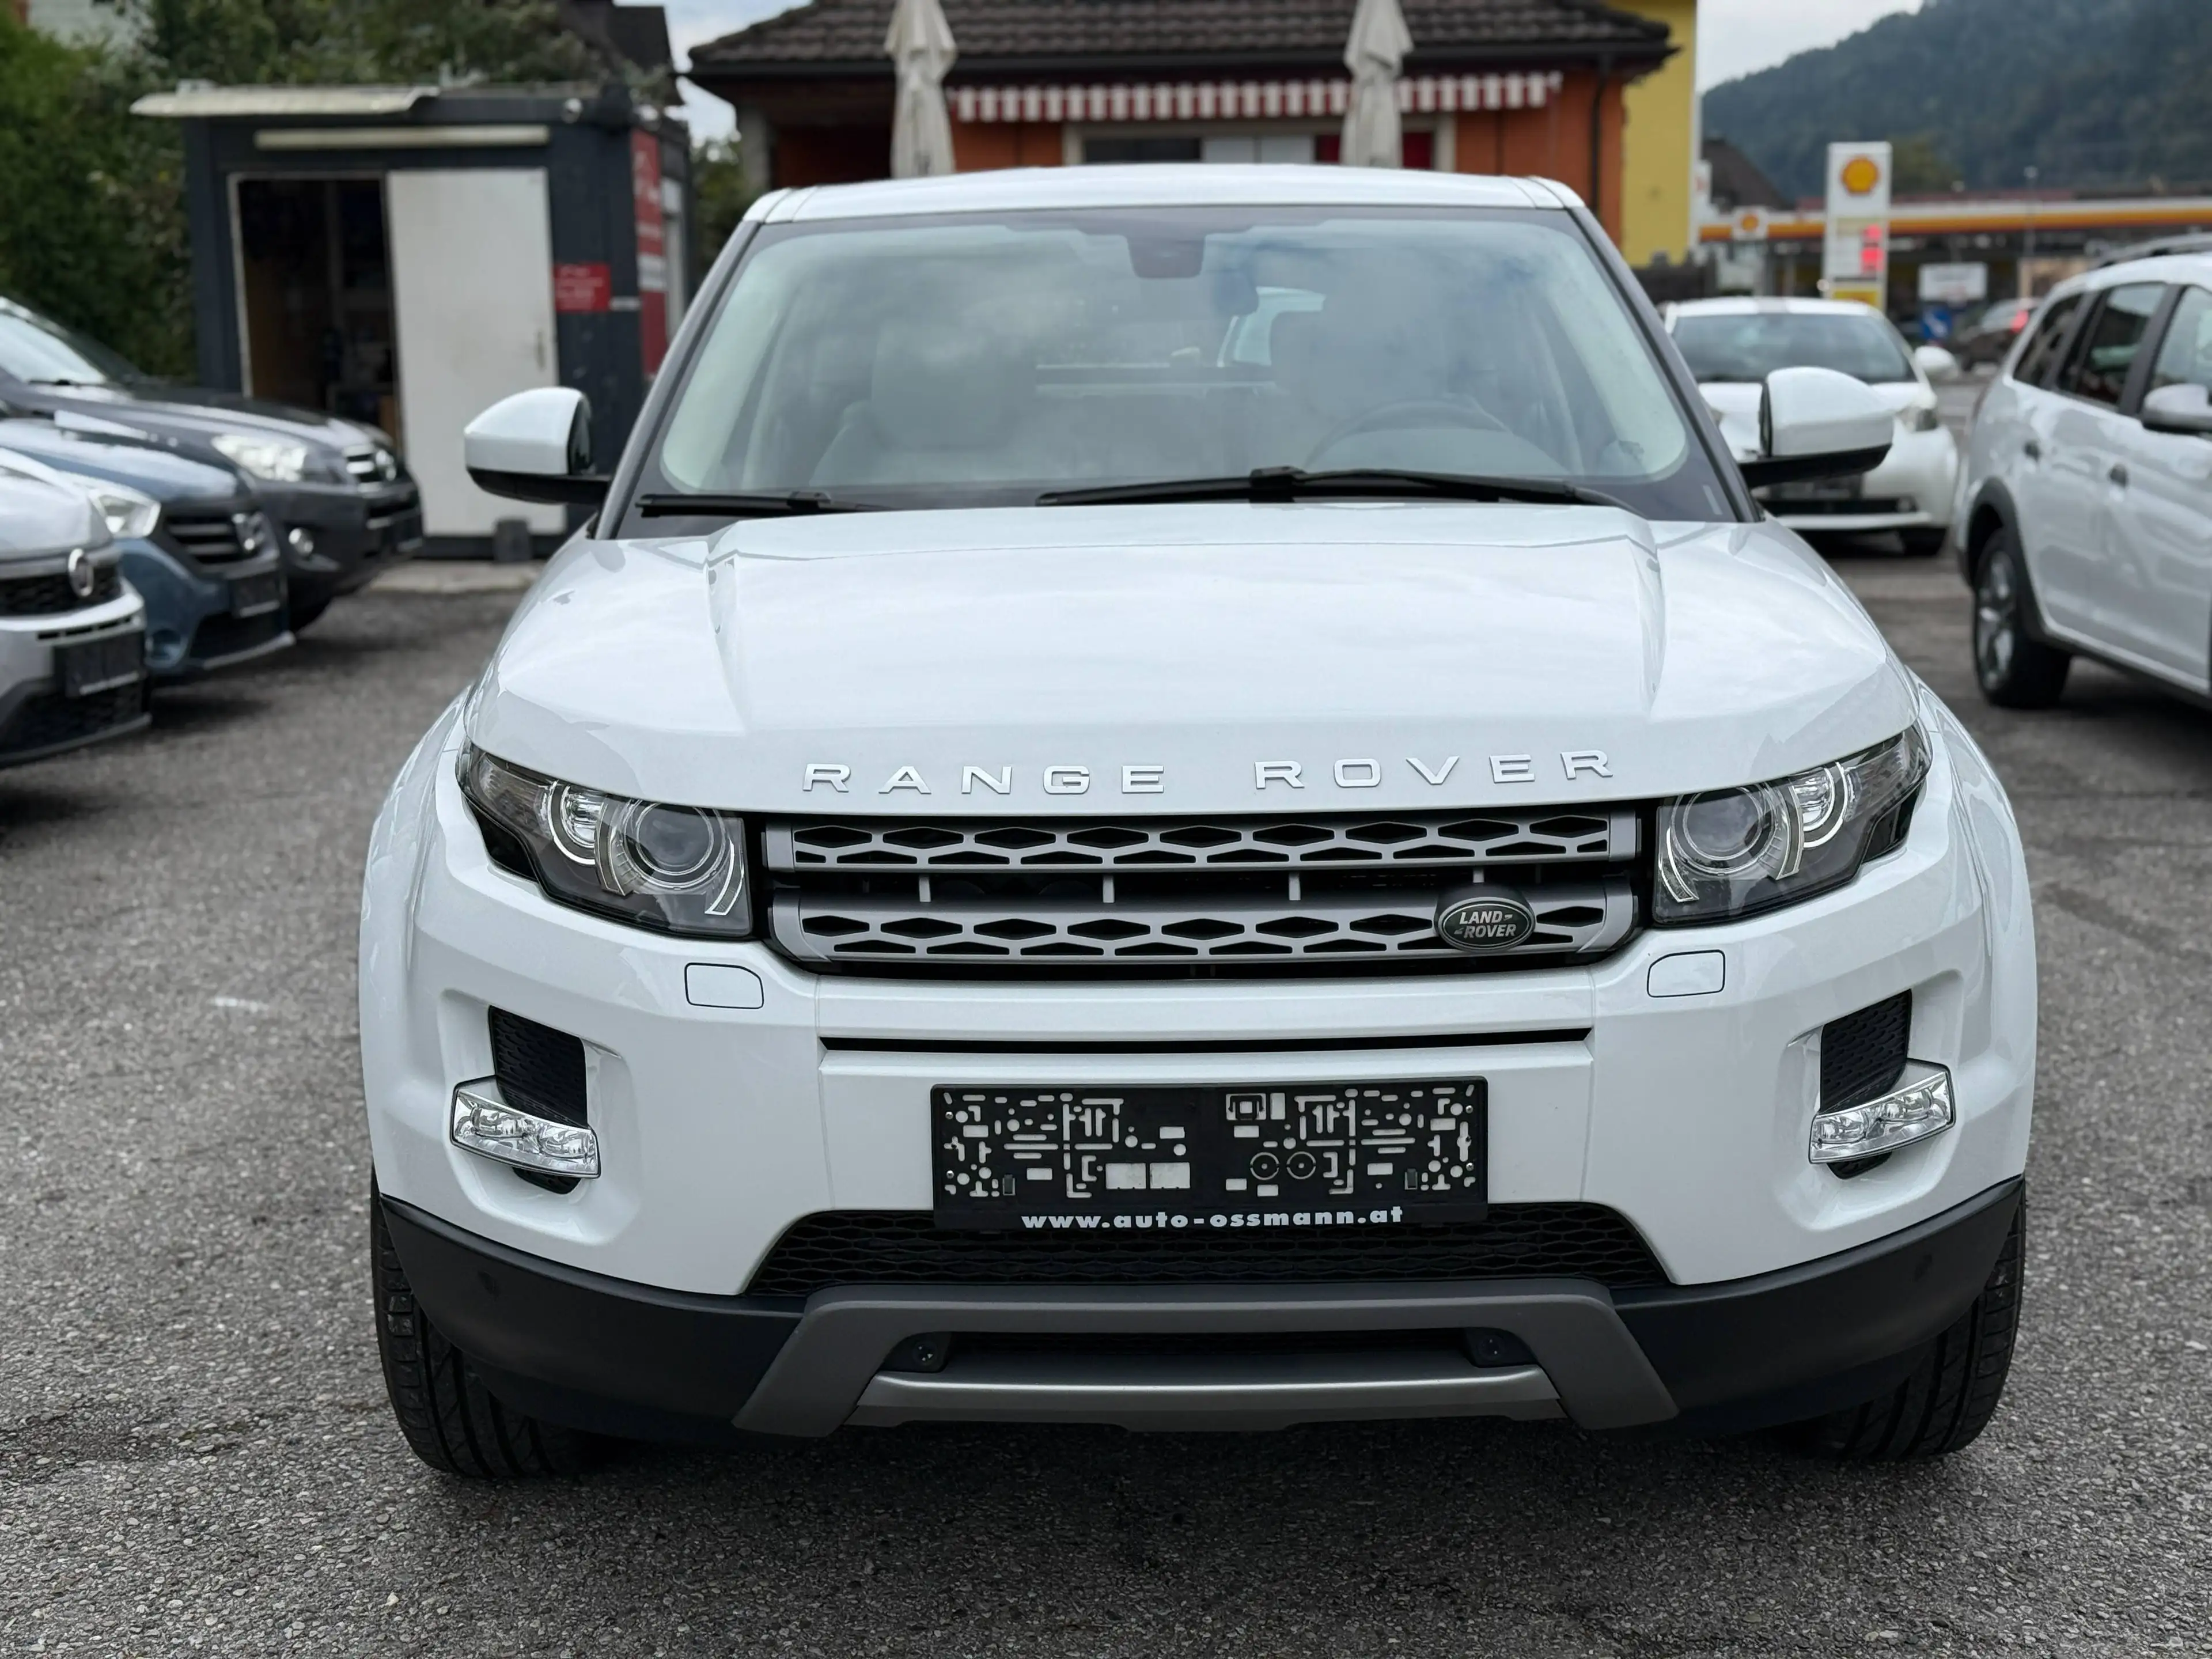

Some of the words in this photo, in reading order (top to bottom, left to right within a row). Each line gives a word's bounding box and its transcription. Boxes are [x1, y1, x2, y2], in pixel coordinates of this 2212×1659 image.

[802, 763, 1164, 794] RANGE
[1254, 749, 1613, 789] ROVER
[1459, 911, 1503, 925] LAND
[1464, 924, 1517, 938] ROVER
[1021, 1206, 1403, 1228] www.auto-ossmann.at
